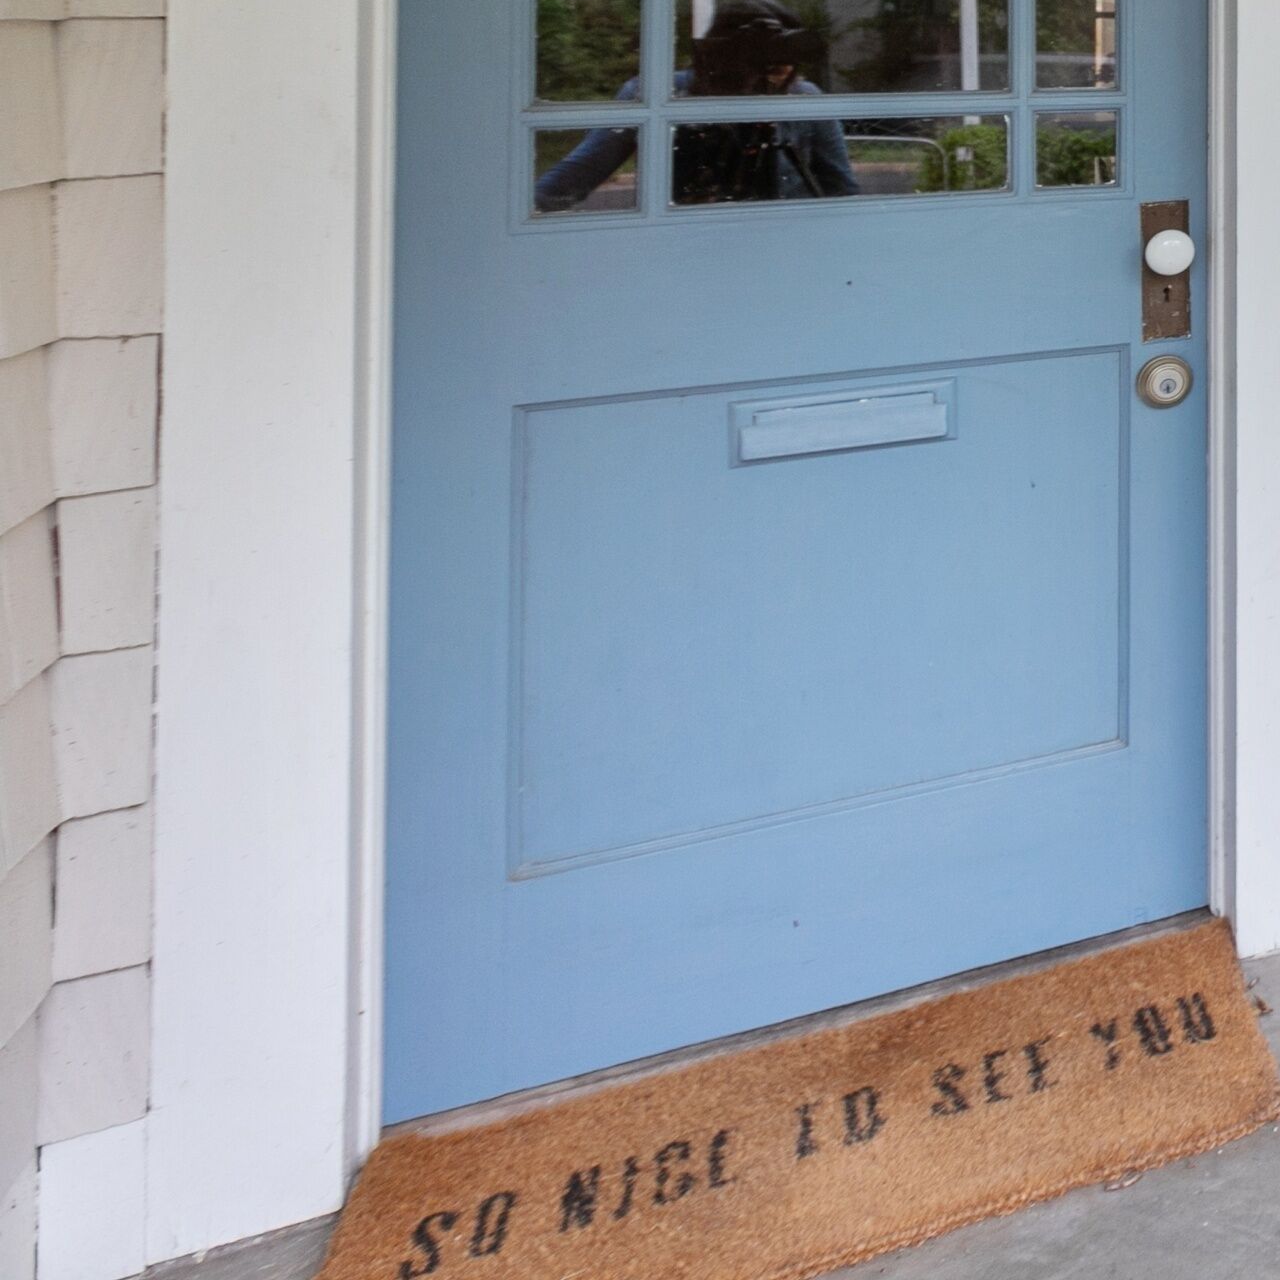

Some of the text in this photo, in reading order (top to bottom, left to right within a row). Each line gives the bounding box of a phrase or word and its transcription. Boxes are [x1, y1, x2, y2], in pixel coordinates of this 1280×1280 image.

[397, 991, 1218, 1280] SO NICE TO SEE YOU
